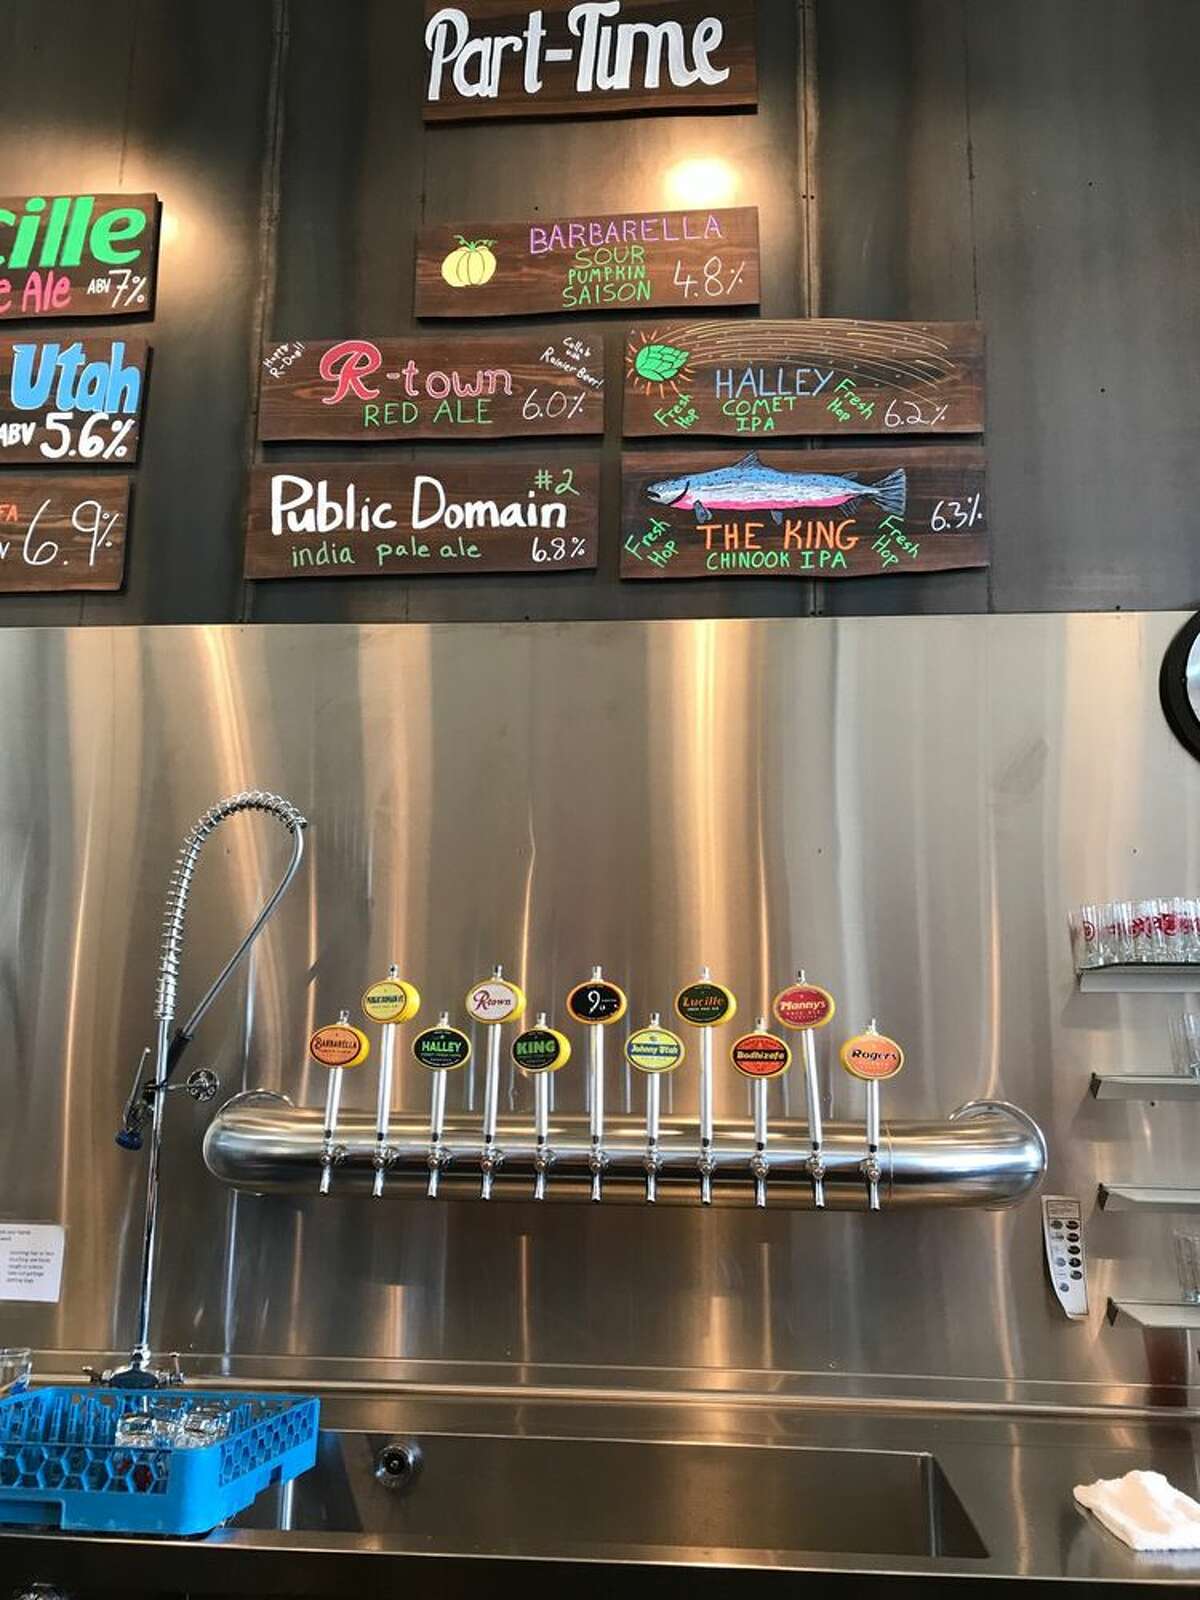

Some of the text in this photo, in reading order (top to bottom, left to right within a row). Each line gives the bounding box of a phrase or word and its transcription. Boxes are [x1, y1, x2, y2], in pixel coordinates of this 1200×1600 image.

[425, 1, 730, 101] Part-Time
[529, 215, 726, 254] BARBARELLA
[574, 245, 645, 269] SOUR
[86, 269, 147, 308] ABV 7%
[568, 265, 646, 285] PUMPKIN
[673, 255, 745, 298] 4.8%
[22, 270, 71, 313] Ale
[562, 280, 651, 307] SAISON
[10, 342, 141, 414] Utah
[319, 340, 512, 405] R-town
[715, 367, 834, 399] HALLEY
[364, 399, 493, 428] RED ALE
[522, 388, 587, 420] 6.0%
[653, 392, 694, 428] Fresh
[722, 396, 797, 416] COMET
[826, 397, 851, 422] Hop
[833, 378, 875, 421] Fresh
[884, 398, 949, 428] 6.2%
[673, 408, 700, 430] Hop
[736, 416, 776, 433] IPA
[40, 412, 136, 460] 5.6%
[534, 468, 580, 496] #2
[271, 474, 567, 536] Public Domain
[23, 498, 120, 567] 6.9%
[624, 517, 672, 561] Fresh
[696, 519, 859, 551] THE KING
[878, 513, 921, 560] Fresh
[292, 535, 482, 567] india pale ale
[531, 536, 586, 562] 6.8%
[647, 540, 679, 569] Hop
[706, 550, 847, 571] CHINOOK IPA
[871, 533, 900, 568] Hop
[421, 1041, 462, 1052] HALLEY
[516, 1040, 556, 1055] KING
